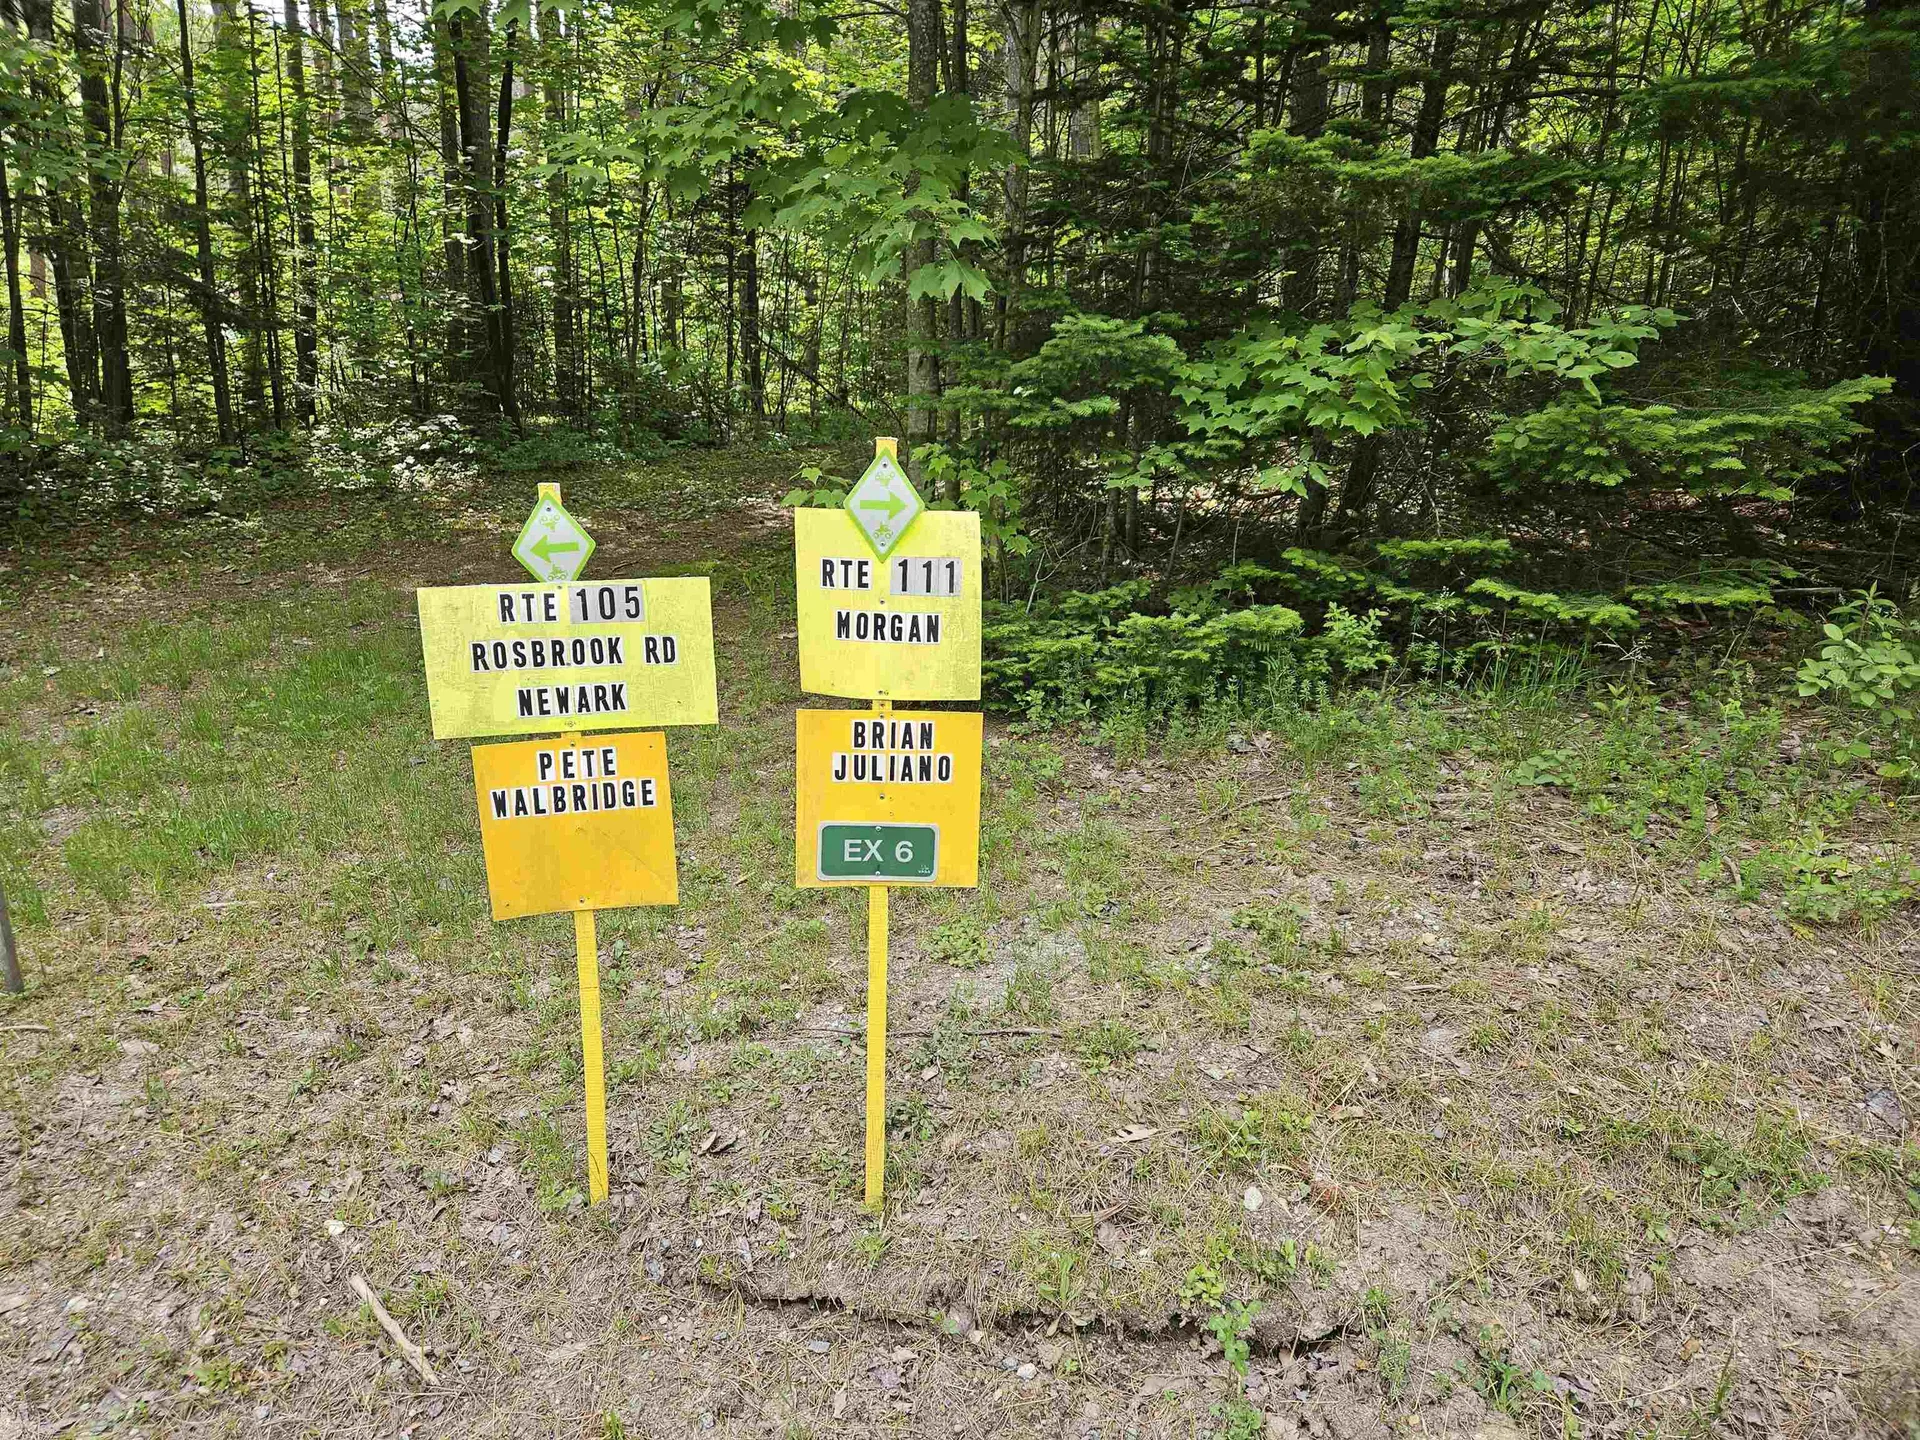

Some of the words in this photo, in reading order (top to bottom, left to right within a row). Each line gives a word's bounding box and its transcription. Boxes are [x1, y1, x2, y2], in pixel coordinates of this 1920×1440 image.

[822, 558, 869, 588] RTE
[898, 559, 955, 593] 111
[500, 593, 556, 622] RTE
[577, 586, 640, 620] 105
[837, 611, 939, 642] MORGAN
[472, 637, 622, 671] ROSBROOK
[645, 636, 676, 664] RD
[518, 684, 626, 716] NEWARK
[853, 721, 933, 749] BRIAN
[539, 749, 615, 780] PETE
[834, 755, 950, 781] JULIANO
[492, 779, 654, 817] WALBRIDGE
[843, 839, 883, 862] EX
[895, 841, 914, 862] 6
